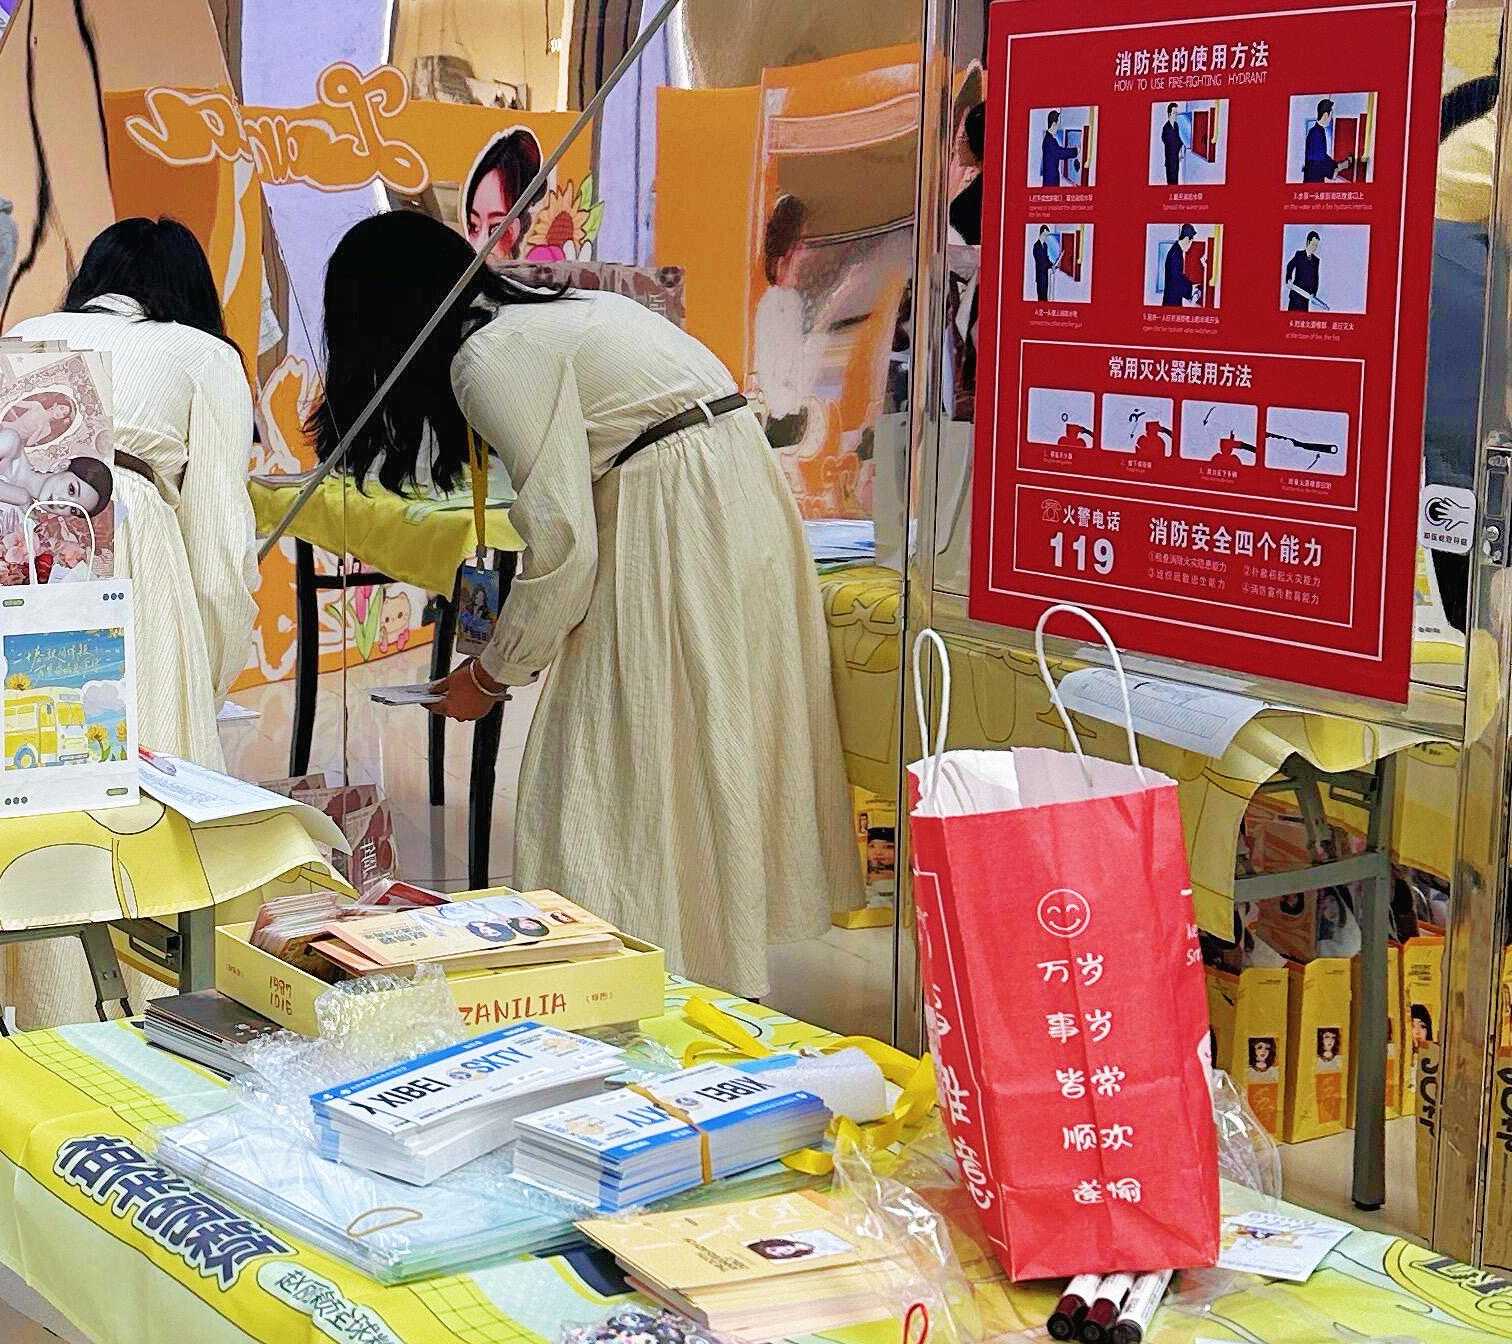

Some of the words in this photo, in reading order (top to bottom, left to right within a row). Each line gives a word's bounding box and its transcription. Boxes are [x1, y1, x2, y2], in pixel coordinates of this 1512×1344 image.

[1115, 40, 1269, 76] 消防栓的使用方法
[1114, 78, 1133, 92] HOW
[1136, 77, 1148, 90] TO
[1150, 76, 1165, 89] USE
[1228, 71, 1267, 86] HYDRANT
[1108, 355, 1253, 388] 常用灭火器使用方法
[1063, 506, 1121, 532] 火警电话
[1050, 531, 1115, 576] 119
[1149, 517, 1323, 567] 消防安全四个能力
[457, 992, 567, 1026] ZANILIA
[370, 1076, 452, 1109] XIBEI
